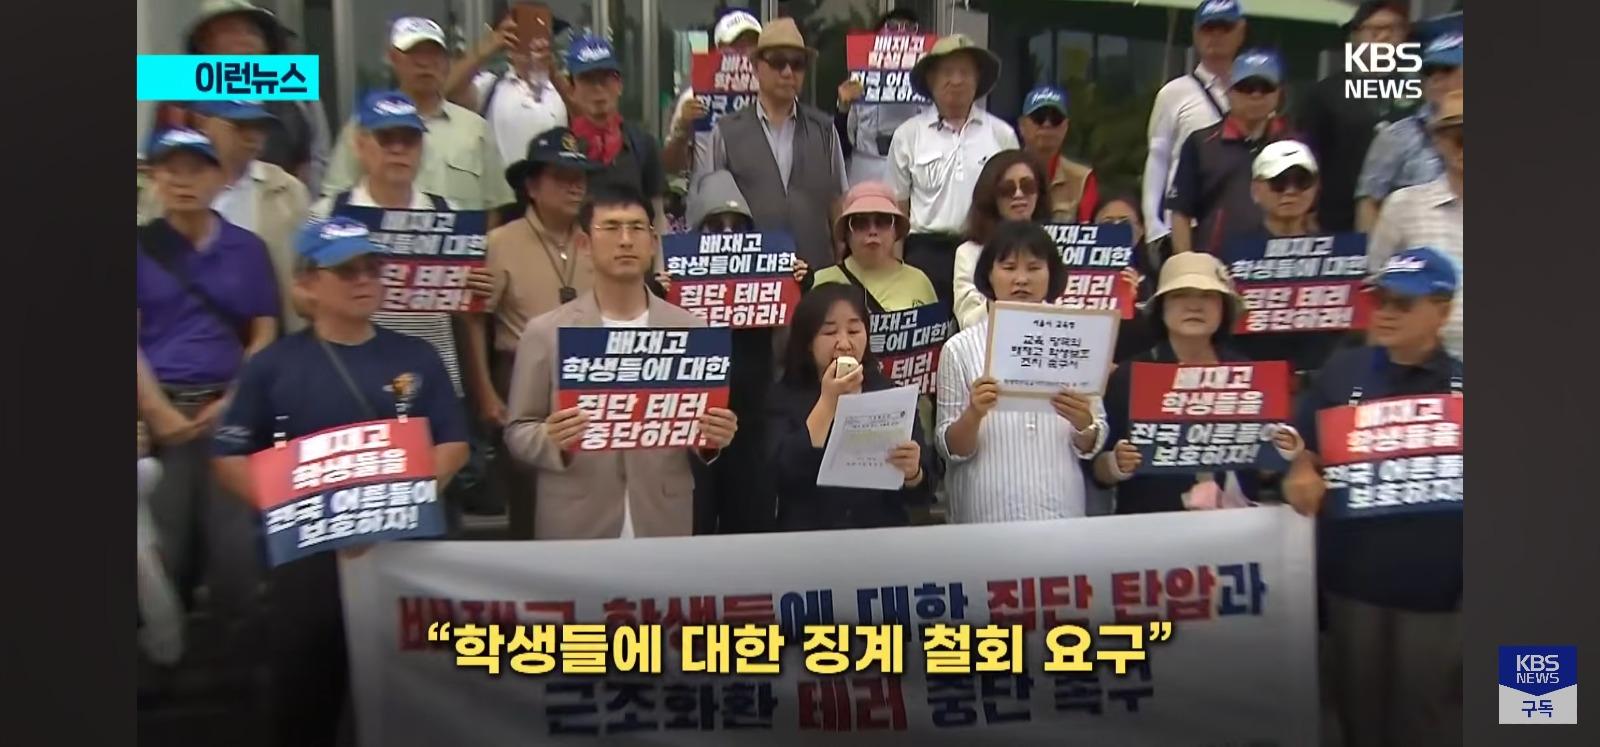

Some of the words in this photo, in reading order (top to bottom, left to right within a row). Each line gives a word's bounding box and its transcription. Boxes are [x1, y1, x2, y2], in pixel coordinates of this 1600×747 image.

[700, 233, 762, 254] 배재고
[667, 254, 752, 276] 학생들에
[756, 252, 798, 274] 대한
[1088, 246, 1132, 267] 대한
[680, 284, 727, 307] 집단
[734, 281, 783, 304] 테러
[1064, 274, 1115, 296] 테러
[1295, 284, 1352, 308] 테러
[605, 330, 690, 355] 배재고
[912, 322, 947, 348] 대한
[562, 356, 674, 383] 학생들에
[676, 356, 731, 381] 대한
[891, 351, 934, 380] 테러
[1172, 366, 1254, 390] 배재고
[577, 393, 639, 422] 집단
[645, 392, 709, 420] 테러
[1161, 391, 1264, 416] 학생들을
[1130, 422, 1182, 445] 전국
[292, 449, 408, 490] 학생들을
[330, 480, 438, 514] 어른들이
[986, 574, 1093, 632] 집단
[1111, 562, 1268, 622] 탄압과
[797, 675, 908, 732] 테러
